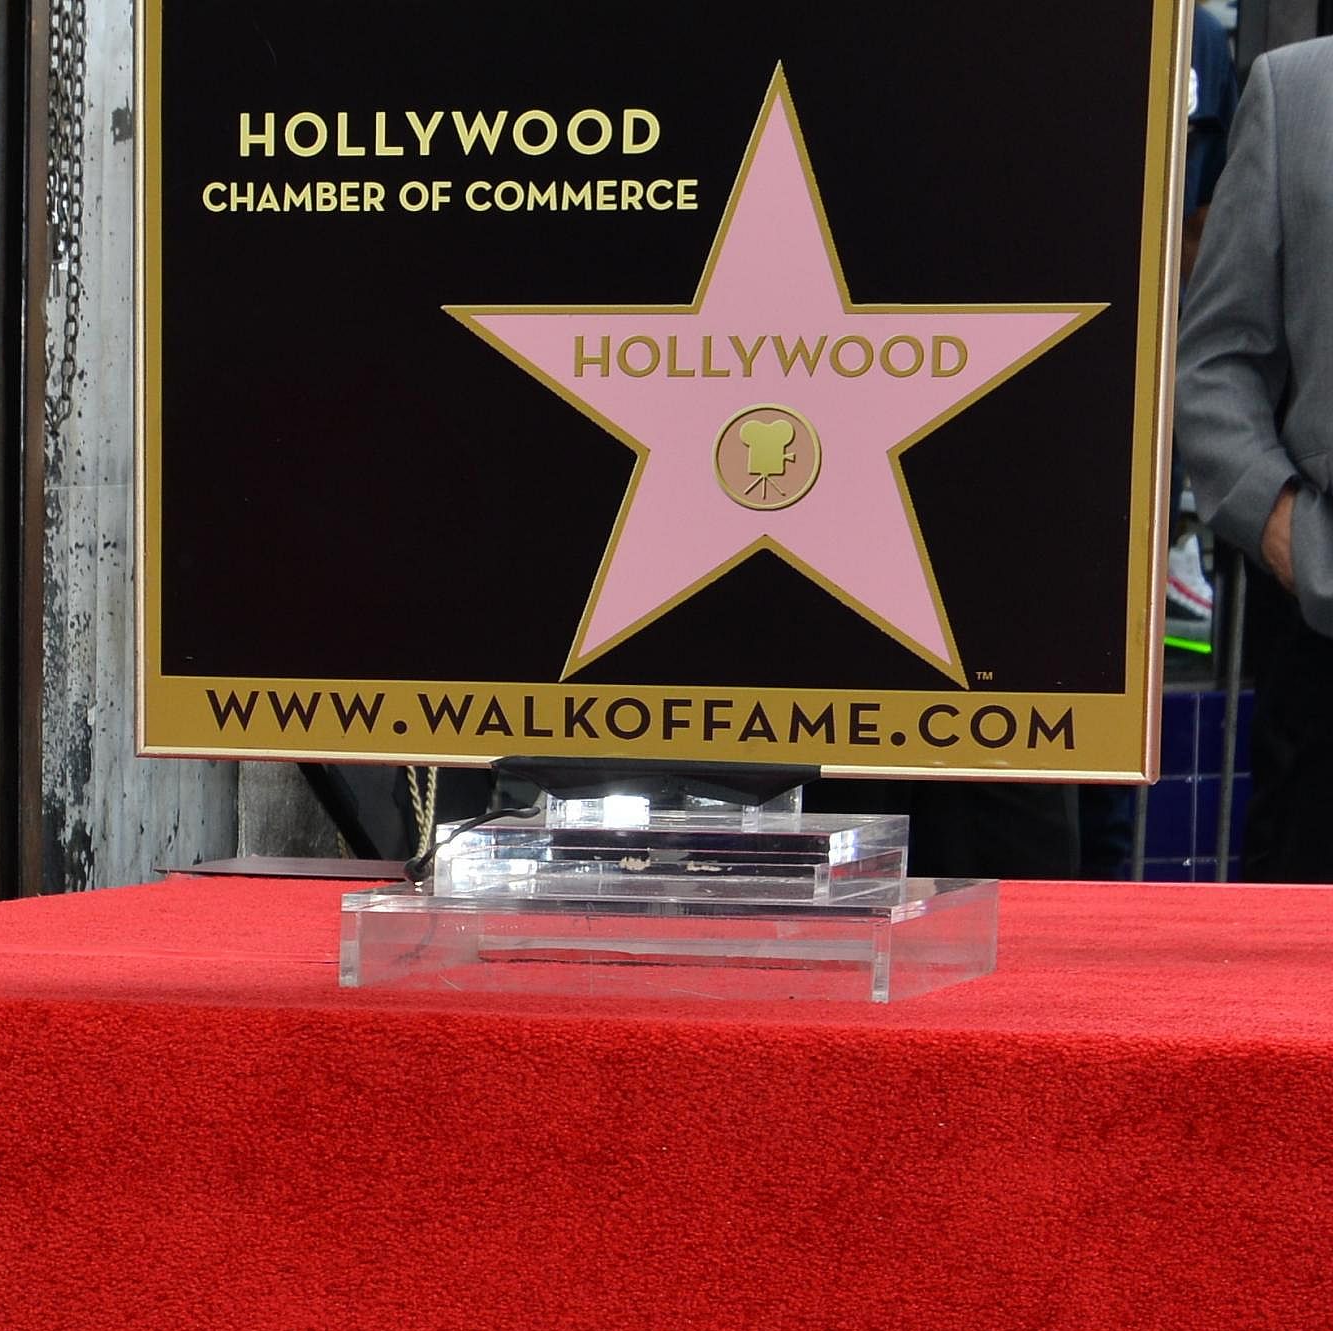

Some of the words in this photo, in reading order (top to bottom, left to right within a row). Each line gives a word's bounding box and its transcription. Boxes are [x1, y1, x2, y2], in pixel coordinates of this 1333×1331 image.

[240, 109, 660, 156] HOLLYWOOD
[203, 182, 385, 212] CHAMBER
[399, 181, 451, 211] OF
[466, 180, 697, 211] COMMERCE
[572, 333, 968, 380] HOLLYWOOD
[976, 672, 993, 680] TM
[206, 690, 1077, 750] WWW.WALKOFFAME.COM
